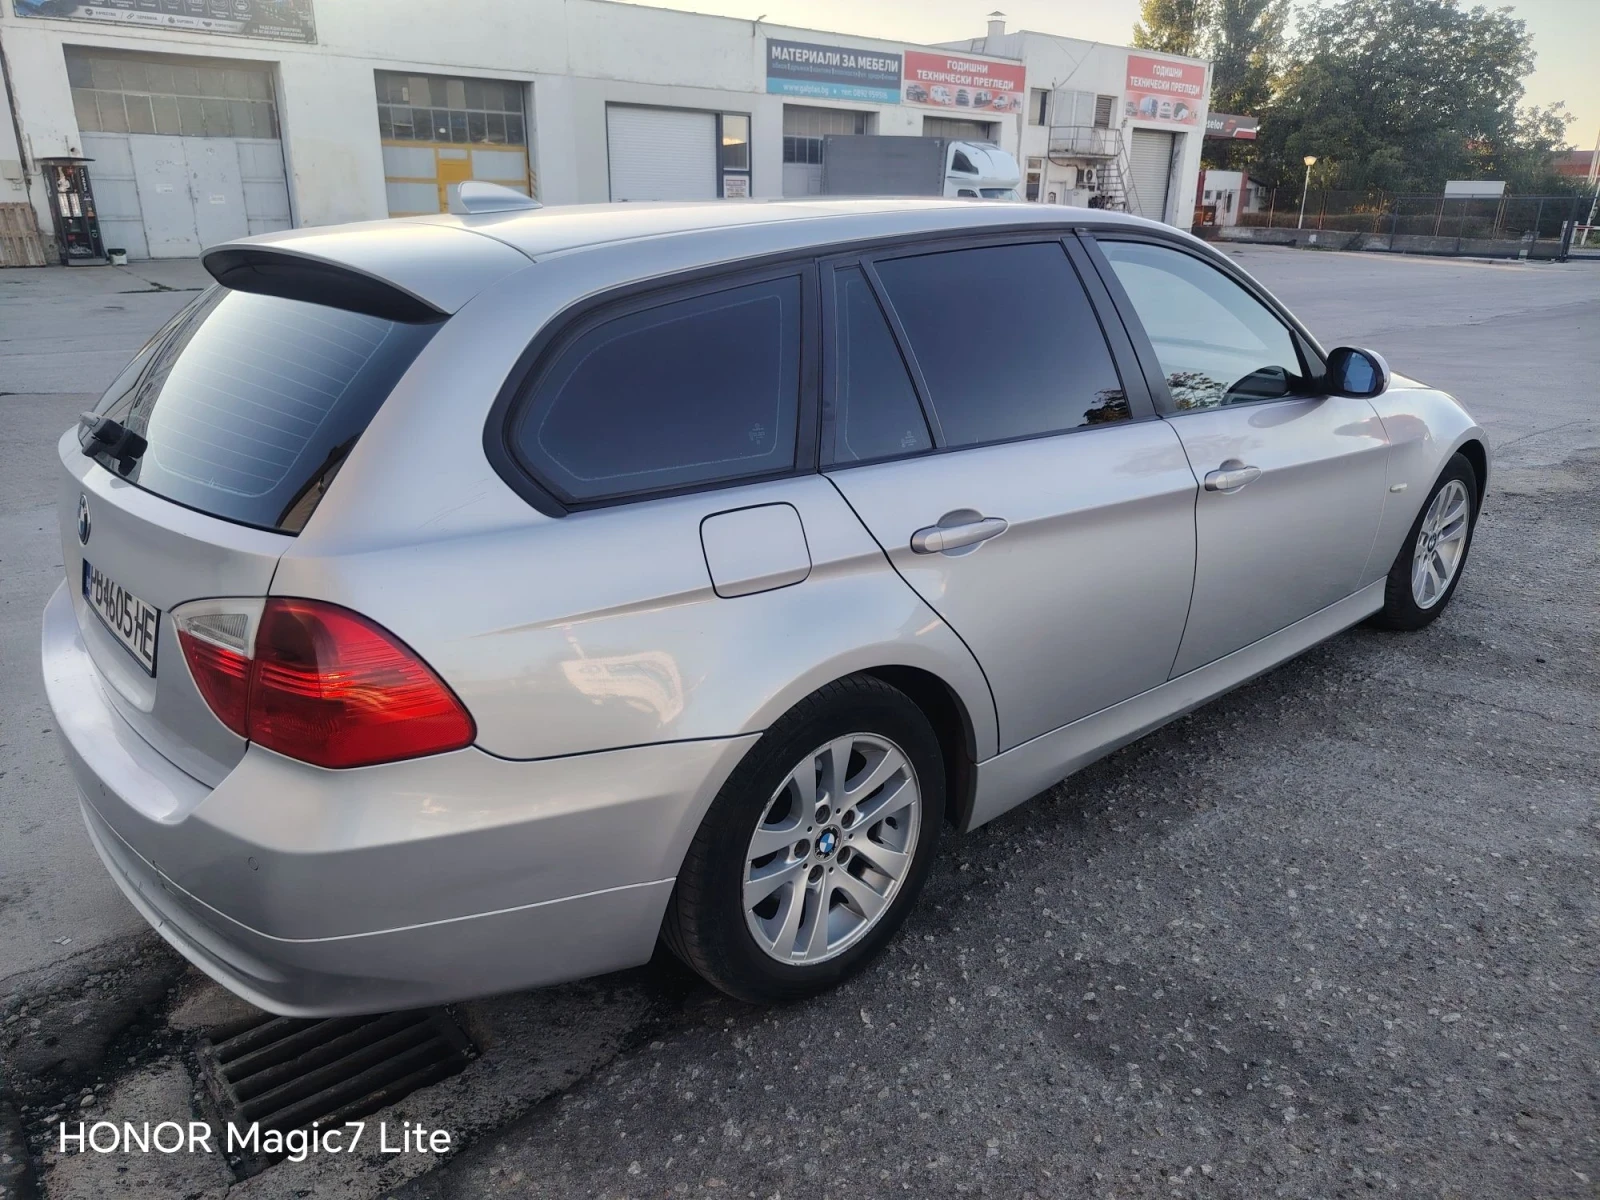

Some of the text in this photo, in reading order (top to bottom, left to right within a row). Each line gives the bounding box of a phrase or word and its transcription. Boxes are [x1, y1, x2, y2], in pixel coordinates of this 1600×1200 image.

[771, 46, 840, 66] МАТЕРИАЛИ
[842, 57, 856, 68] ЗА
[857, 58, 899, 73] МЕБЕЛИ
[946, 59, 988, 74] ГОДИШНИ
[1152, 64, 1182, 77] ГОДИШНИ
[917, 69, 972, 86] ТЕХНИЧЕСКИ
[973, 77, 1014, 91] ПРЕГЛЕДИ
[1130, 75, 1200, 96] ТЕХНИЧЕСКИ ПРЕГЛЕДИ
[1206, 119, 1224, 130] selor
